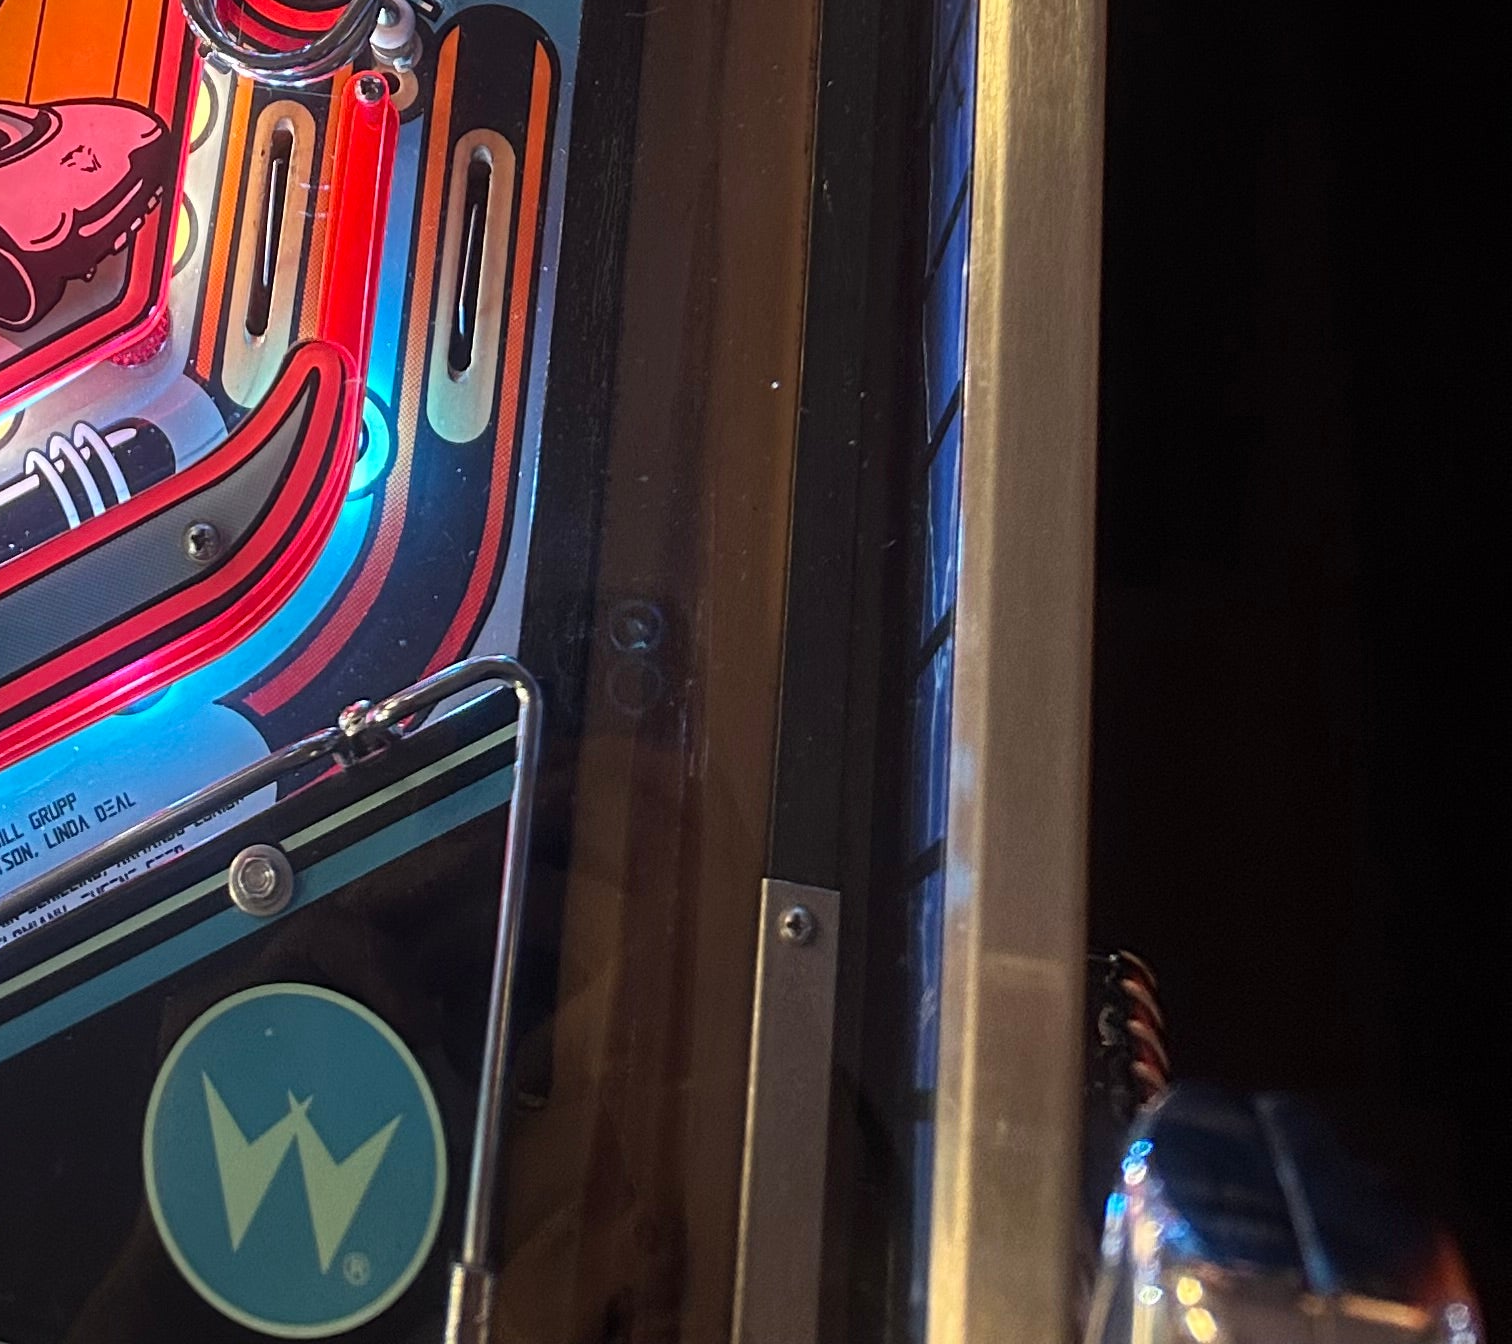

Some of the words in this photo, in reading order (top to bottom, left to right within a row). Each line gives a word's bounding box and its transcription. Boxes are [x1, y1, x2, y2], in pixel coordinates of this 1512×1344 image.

[27, 792, 78, 831] GRUPP
[43, 814, 91, 850] LINDA
[93, 791, 138, 824] DEAL
